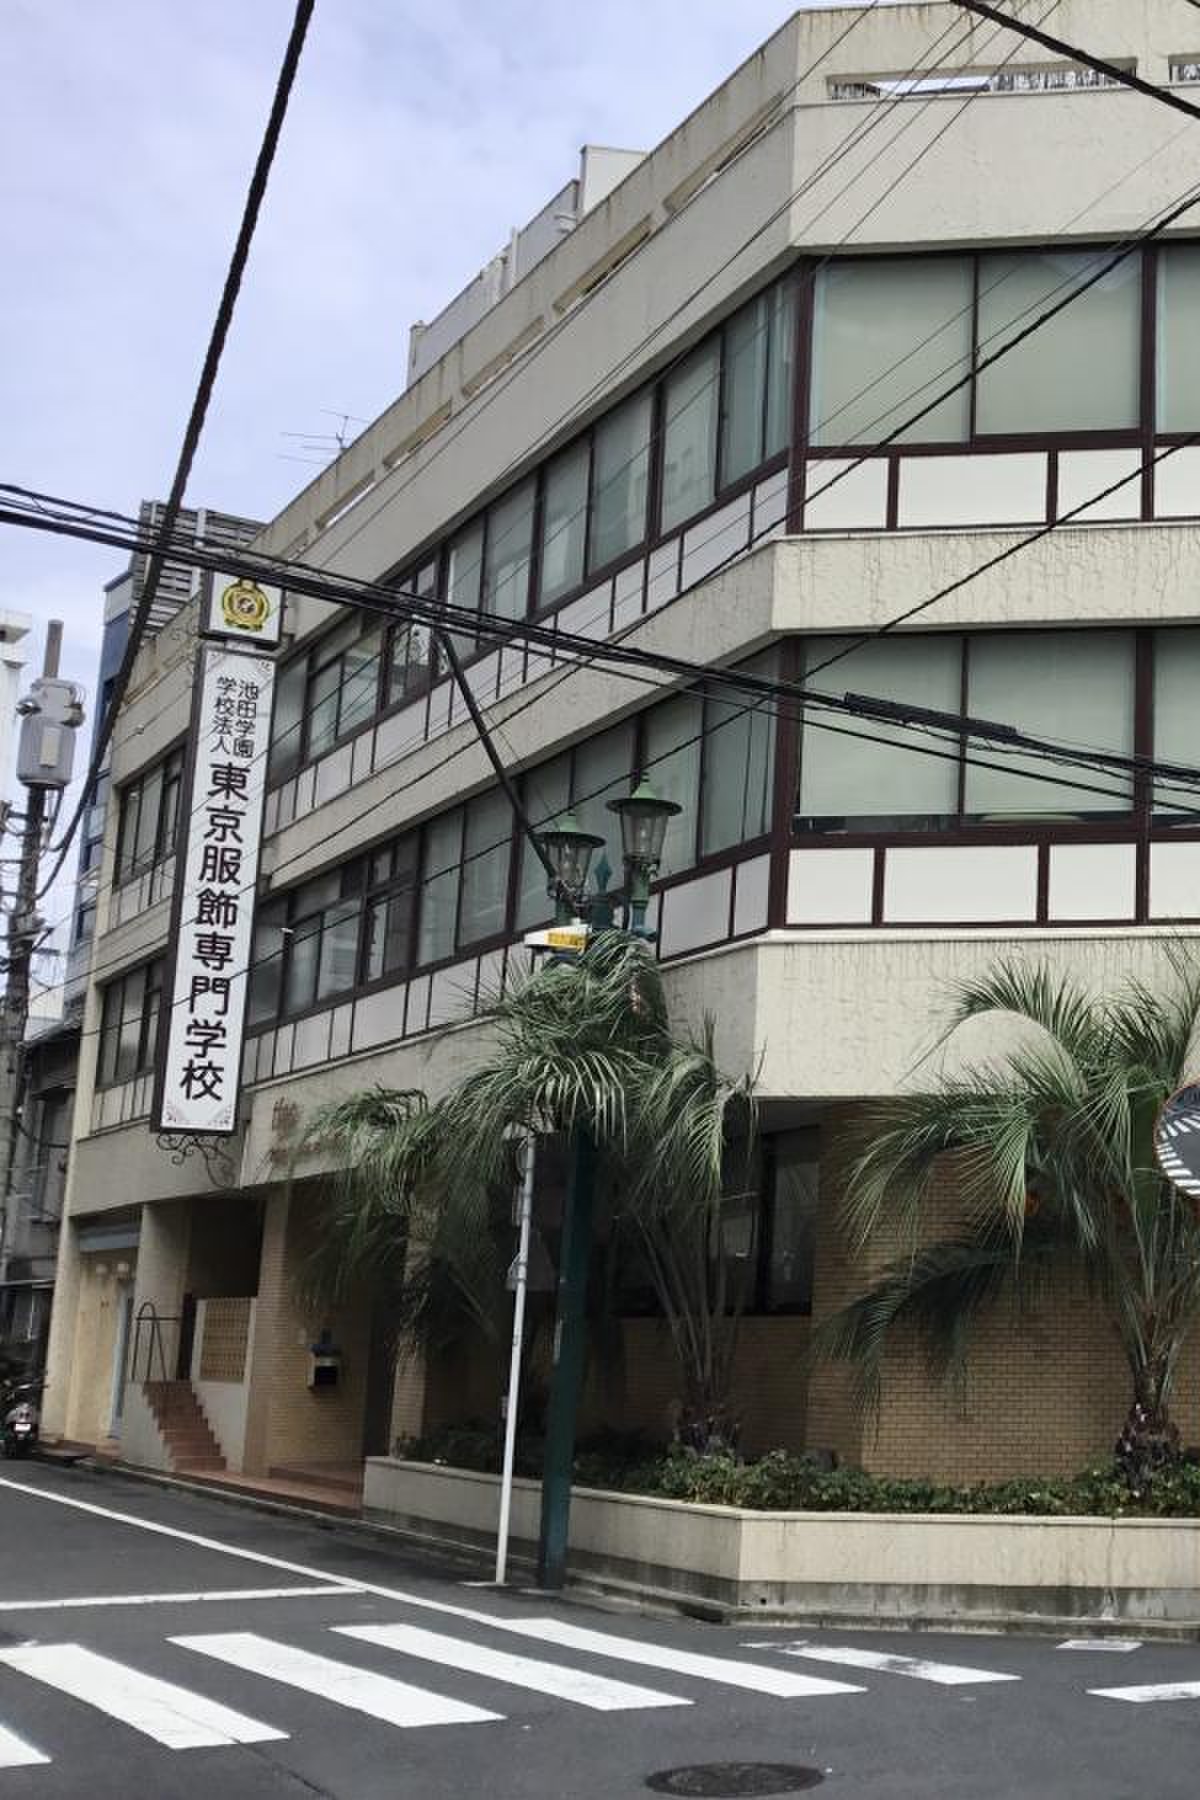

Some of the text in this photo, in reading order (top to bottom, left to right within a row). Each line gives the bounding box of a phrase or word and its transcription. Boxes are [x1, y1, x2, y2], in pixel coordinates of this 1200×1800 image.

[210, 676, 237, 754] 学校法人
[180, 761, 251, 1101] 東京服飾専門学校
